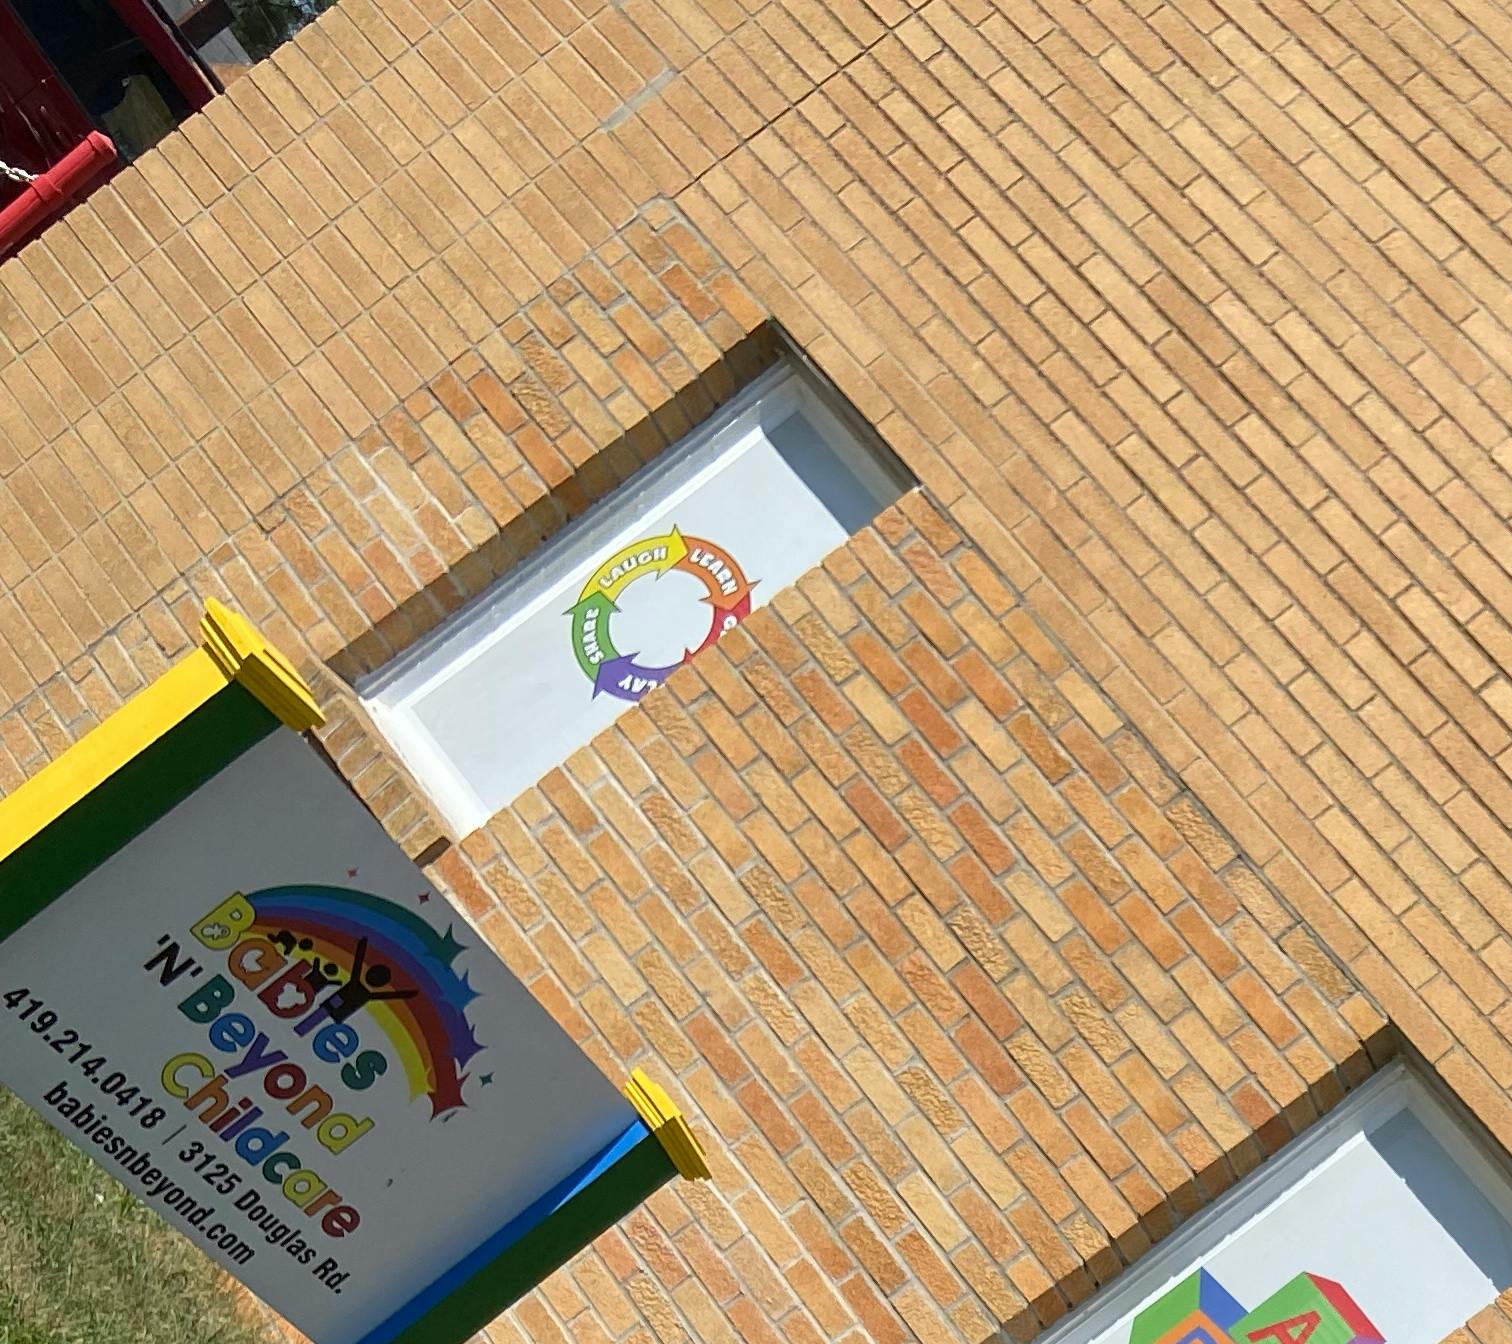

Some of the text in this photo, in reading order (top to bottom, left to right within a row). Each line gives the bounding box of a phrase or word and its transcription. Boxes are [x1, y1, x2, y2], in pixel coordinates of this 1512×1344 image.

[582, 607, 604, 665] SHARE
[598, 546, 668, 589] LAUGH
[689, 547, 738, 596] LEARN
[617, 674, 665, 694] LAY
[177, 973, 375, 1155] Beyond
[189, 891, 388, 1091] Babies
[2, 987, 352, 1295] 419.214.0418 3125 Douglas Rd.
[43, 1080, 256, 1266] babiesnbeyond.com
[161, 1052, 361, 1238] Childcare
